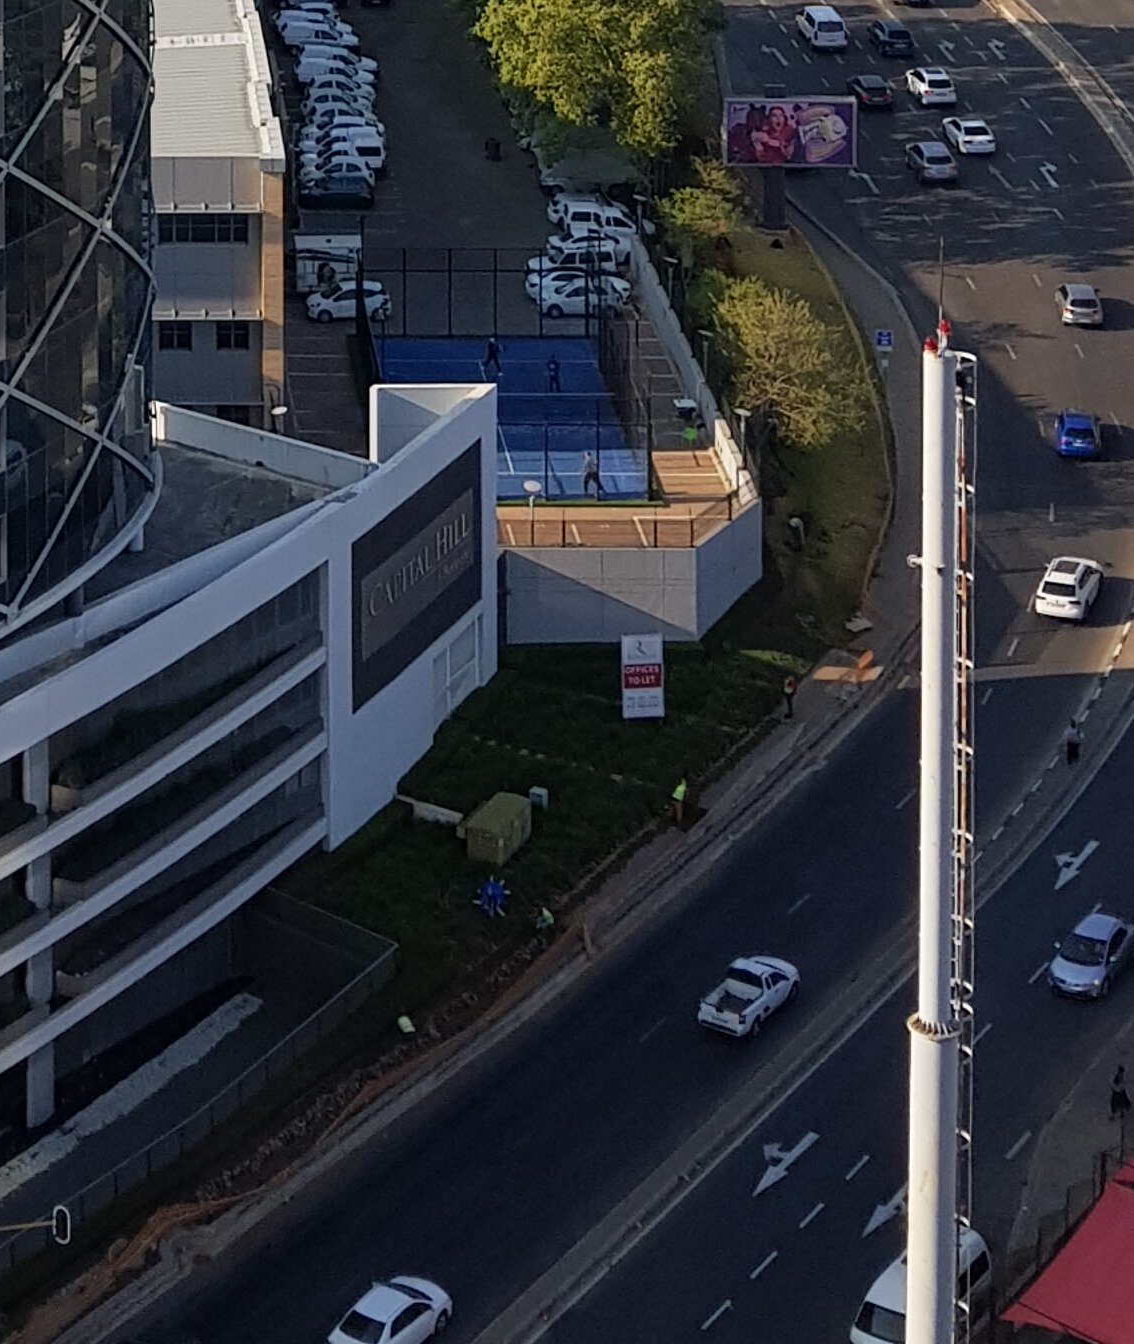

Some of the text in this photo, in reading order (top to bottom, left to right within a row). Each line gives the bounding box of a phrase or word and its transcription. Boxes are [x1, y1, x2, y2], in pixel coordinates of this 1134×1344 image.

[368, 545, 432, 617] CAPITAL
[434, 513, 469, 562] HILL
[625, 665, 659, 674] OFFICES
[628, 675, 656, 685] TO LET
